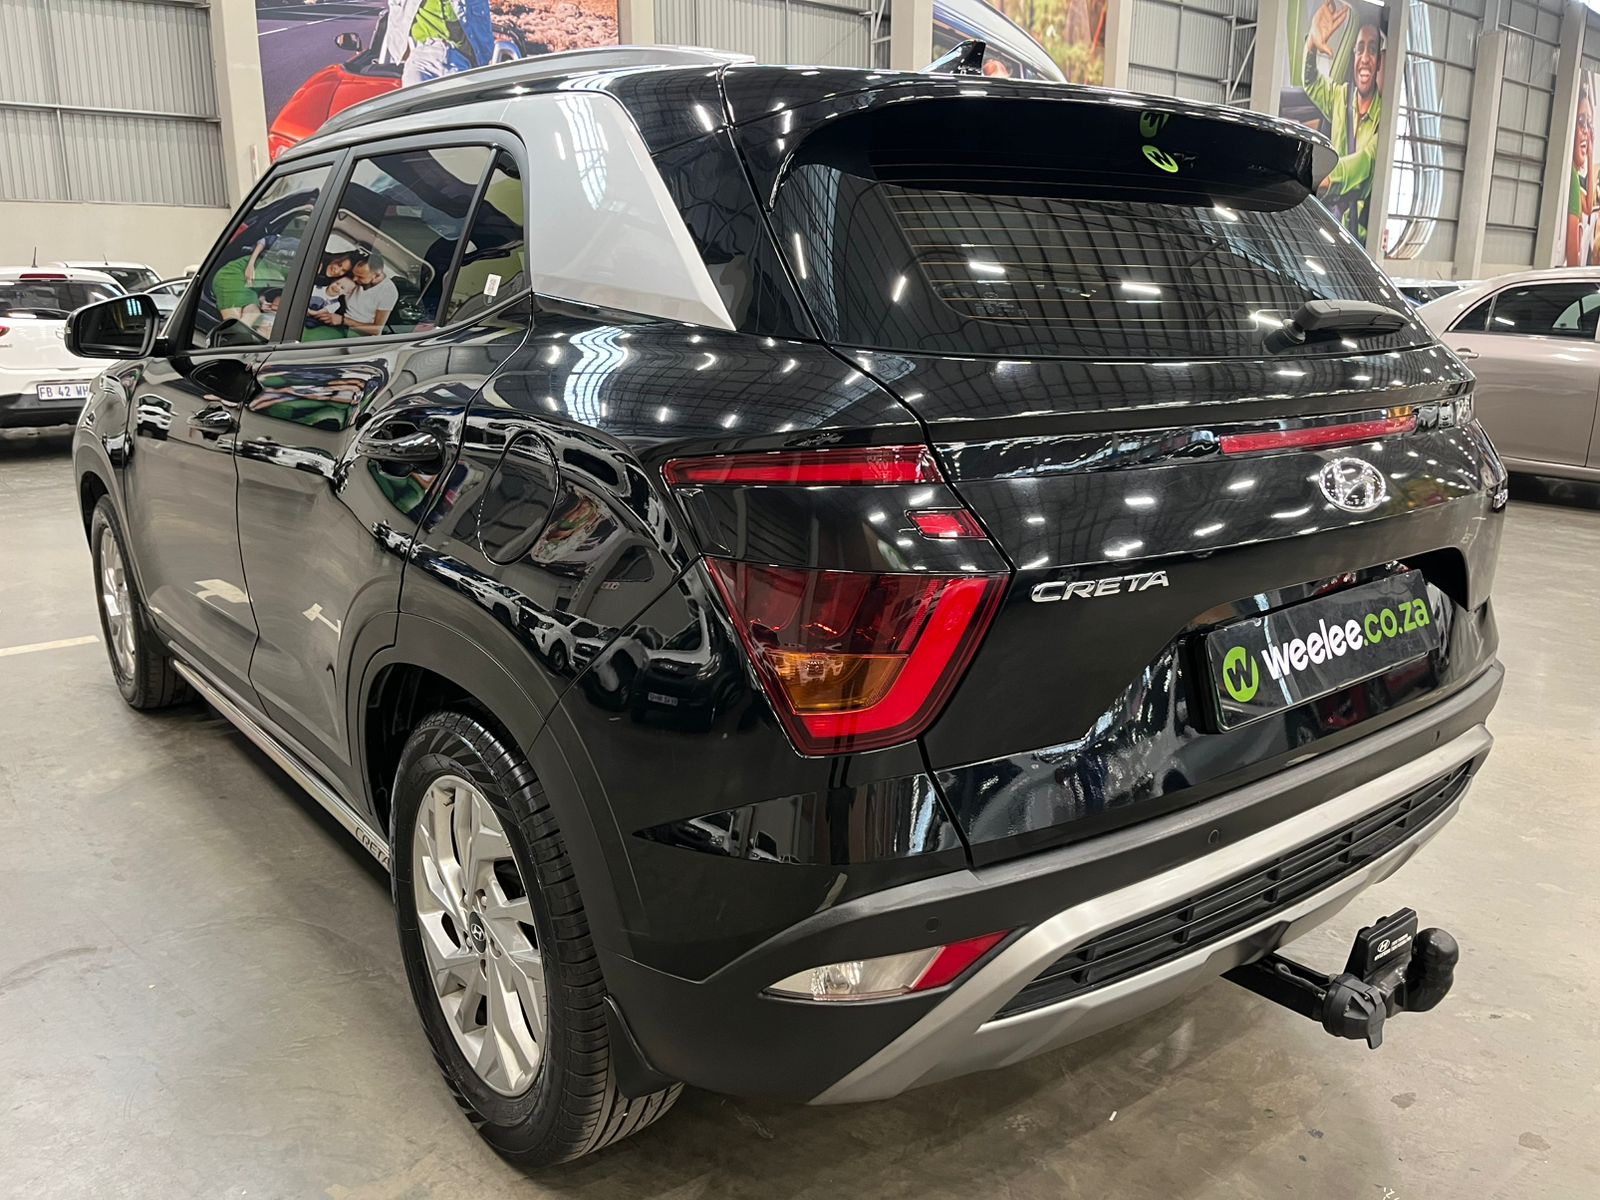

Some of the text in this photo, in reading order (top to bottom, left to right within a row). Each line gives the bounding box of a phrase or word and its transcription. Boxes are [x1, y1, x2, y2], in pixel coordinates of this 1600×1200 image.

[39, 386, 53, 398] FB
[58, 386, 71, 397] 42
[1031, 570, 1170, 602] CRETA
[1261, 598, 1430, 681] weelee.co.za
[355, 826, 390, 867] CRETA
